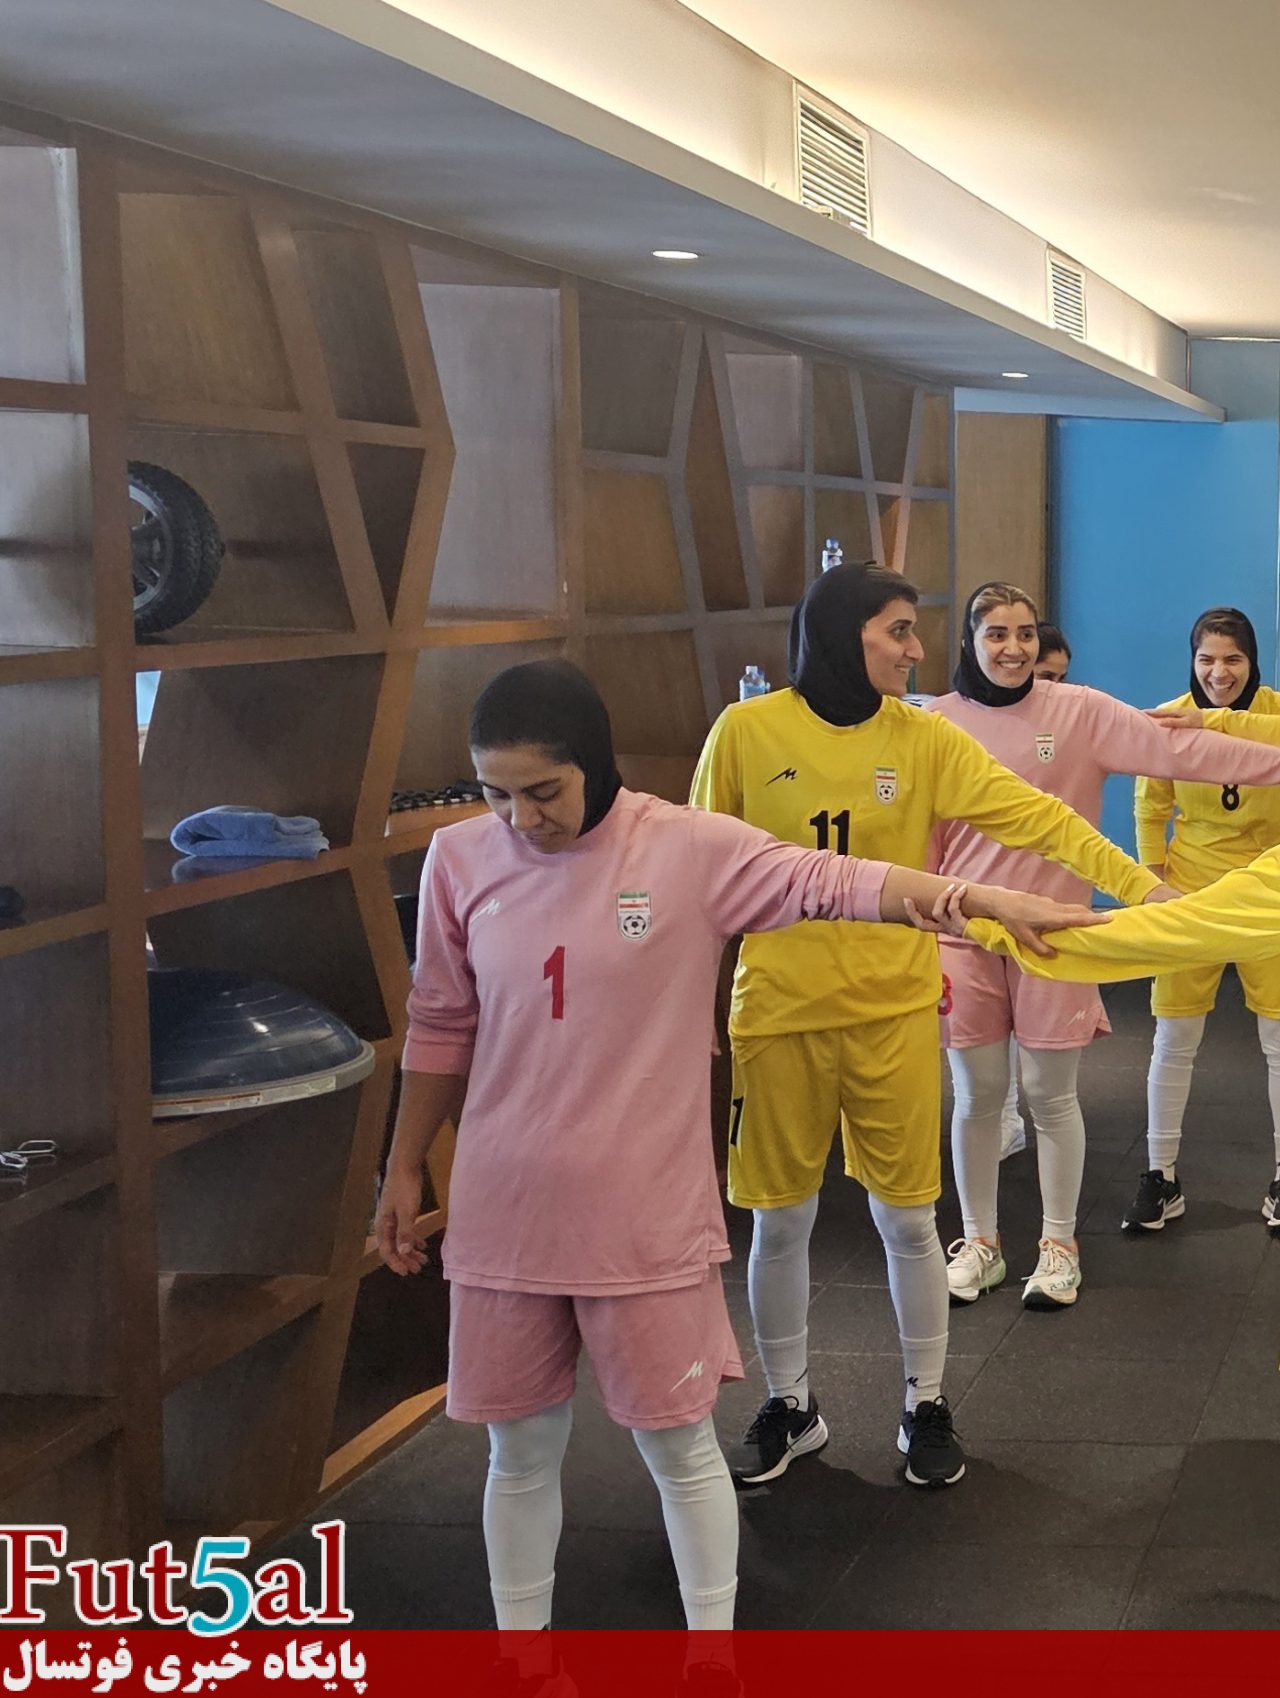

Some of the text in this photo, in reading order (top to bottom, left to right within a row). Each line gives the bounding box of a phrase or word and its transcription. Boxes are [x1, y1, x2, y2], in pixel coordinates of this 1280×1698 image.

[1221, 784, 1240, 812] 8
[809, 809, 850, 855] 11
[544, 945, 566, 1019] 1
